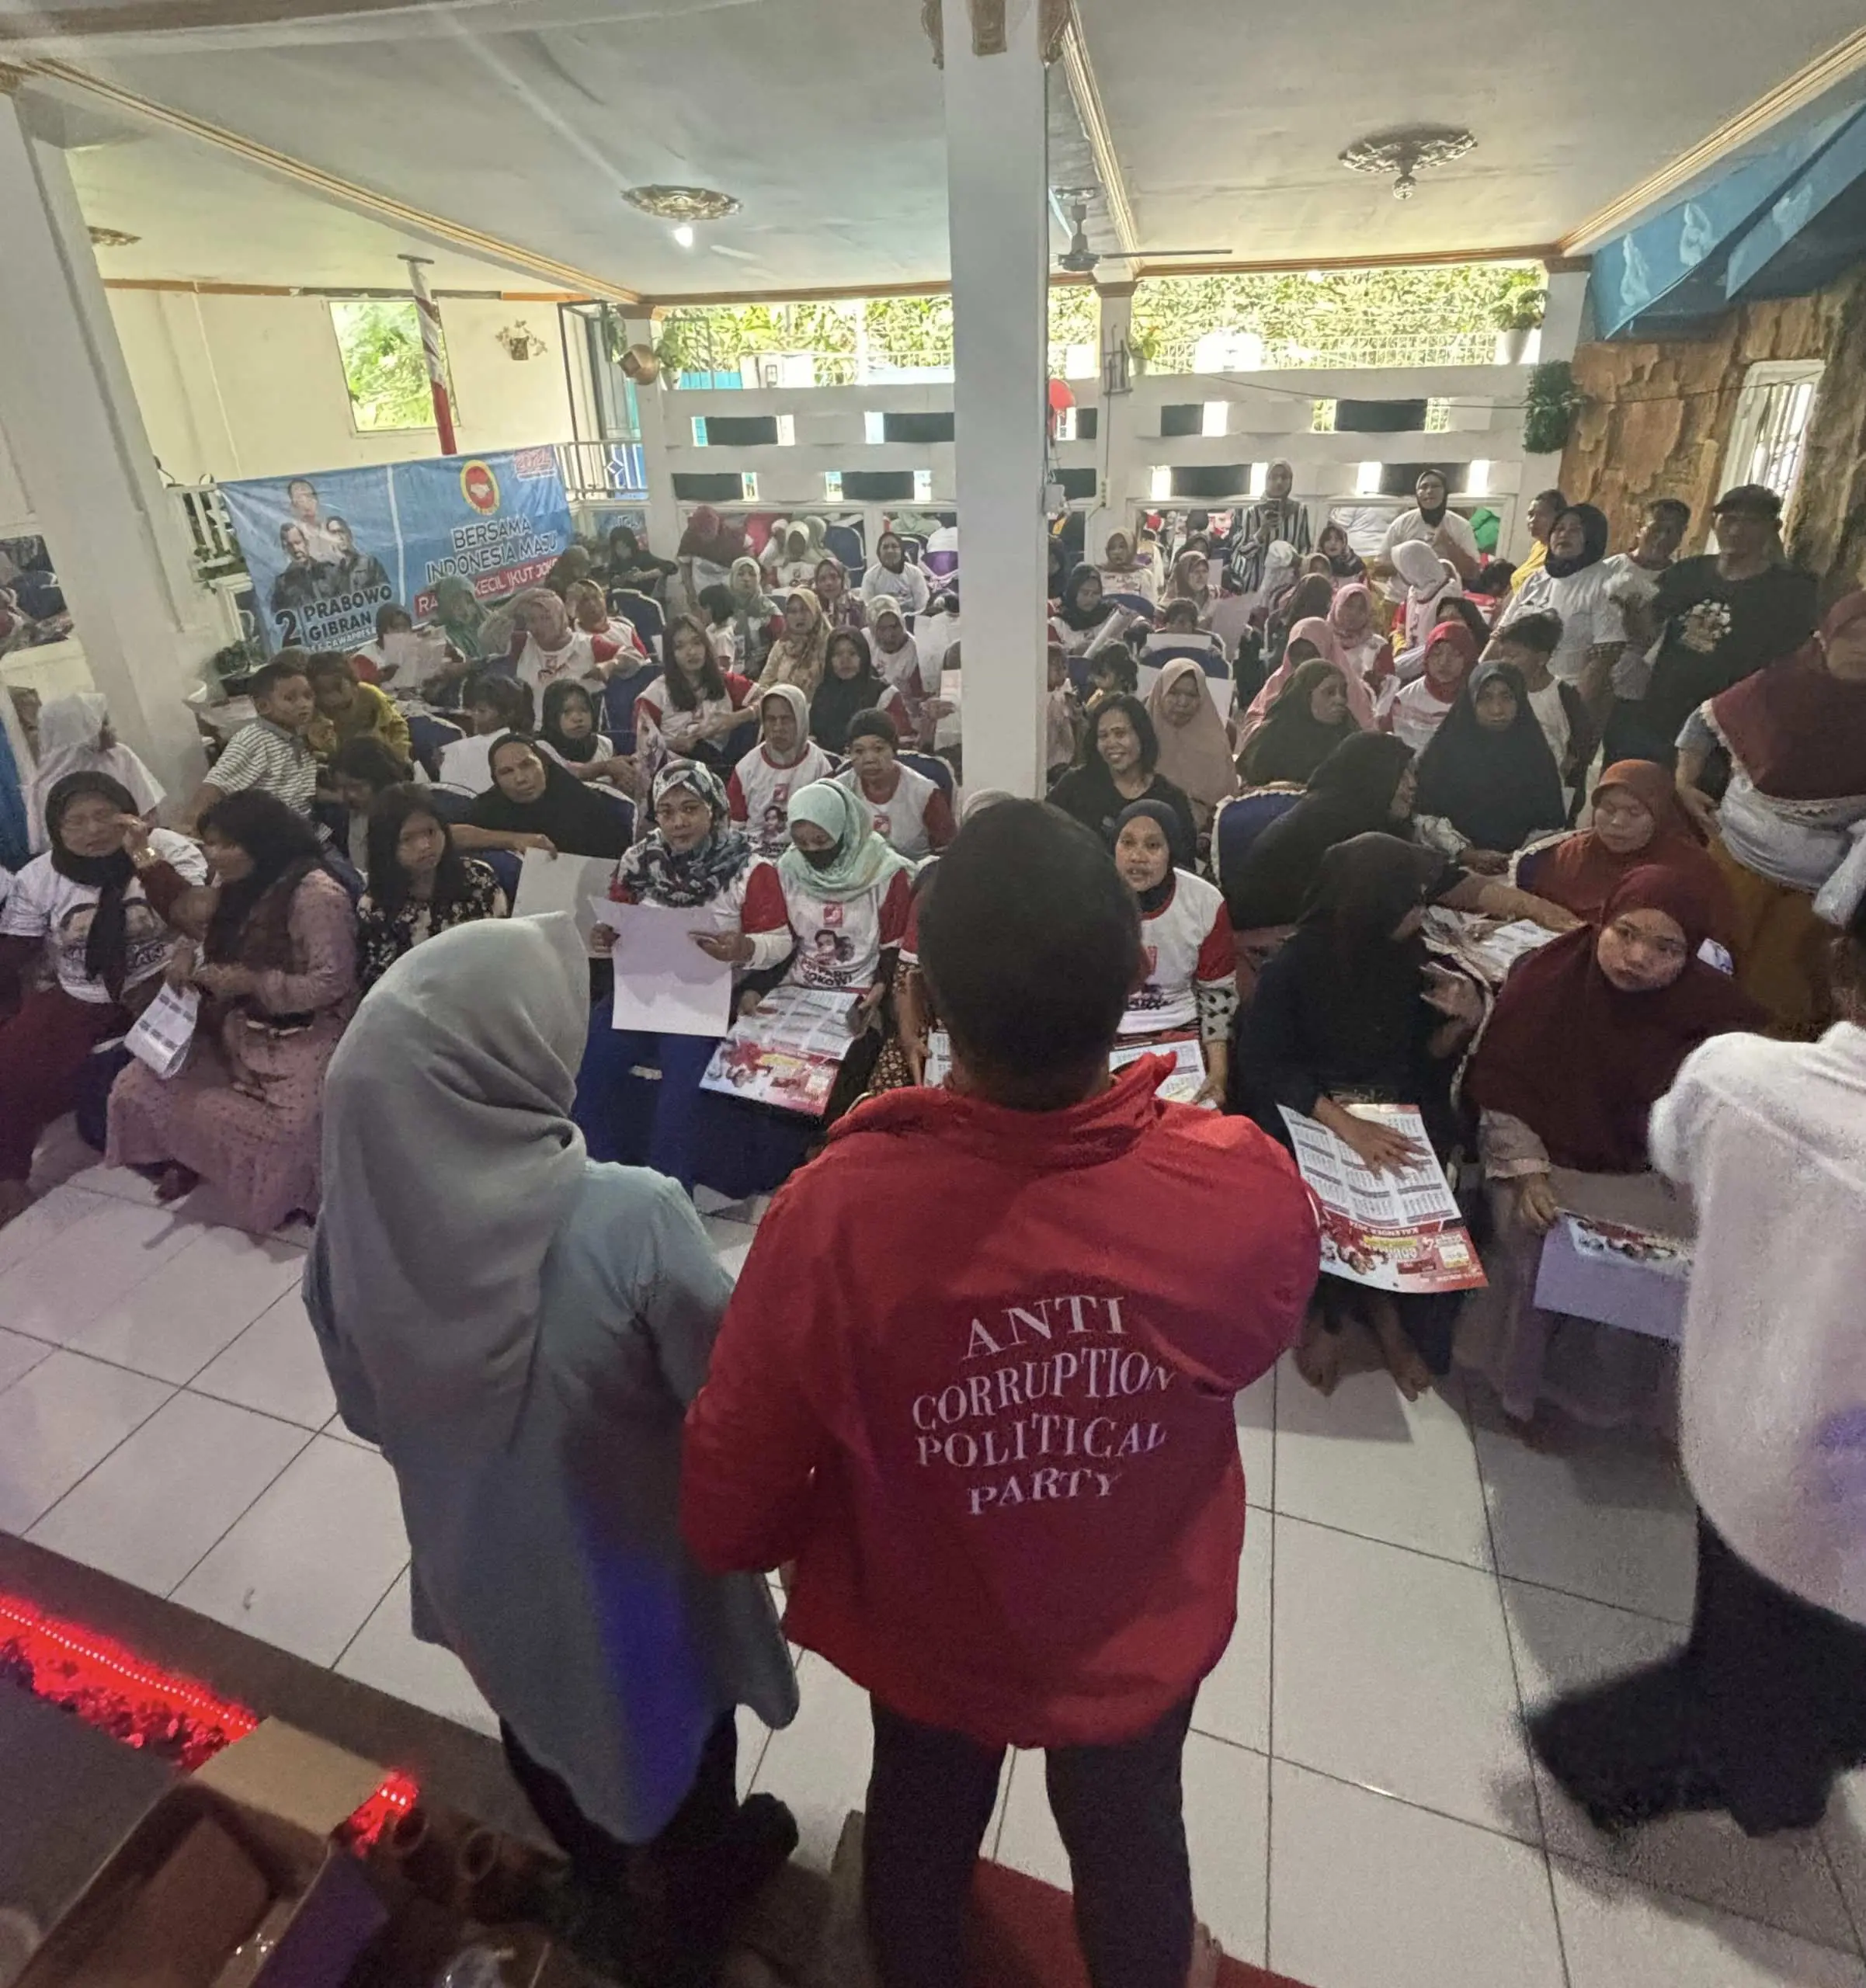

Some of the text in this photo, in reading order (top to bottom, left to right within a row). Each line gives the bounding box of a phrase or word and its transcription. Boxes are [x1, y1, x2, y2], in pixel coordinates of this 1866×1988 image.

[451, 513, 532, 551] BERSAMA
[426, 530, 558, 584] INDONESIA MAJU
[304, 585, 392, 621] PRABOWO
[475, 575, 506, 596] KECIL
[275, 610, 302, 648] 2
[309, 610, 372, 641] GIBRAN
[962, 1294, 1126, 1361] ANTI
[912, 1347, 1176, 1430] CORRUPTION
[916, 1413, 1167, 1468] POLITICAL
[968, 1468, 1123, 1516] PARTY
